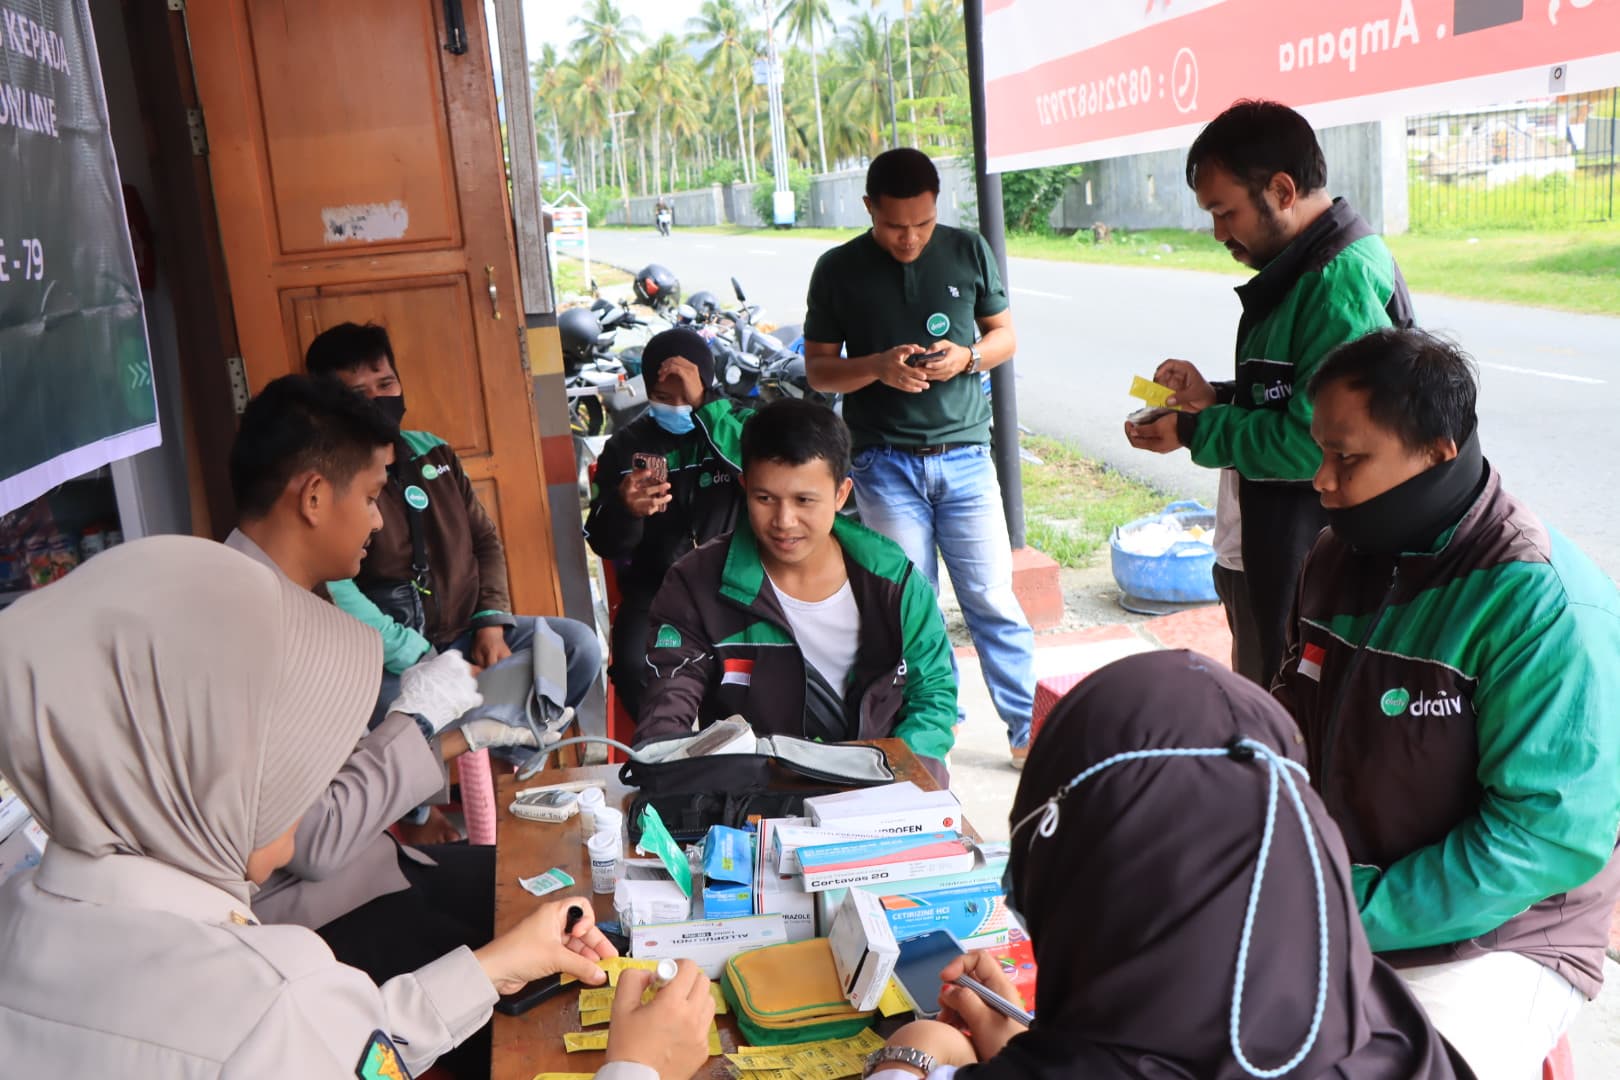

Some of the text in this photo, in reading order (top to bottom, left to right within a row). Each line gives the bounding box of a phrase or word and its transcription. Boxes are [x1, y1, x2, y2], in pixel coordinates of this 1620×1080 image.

[3, 8, 71, 76] KEPADA
[1409, 689, 1461, 716] draiv
[811, 875, 868, 887] Cortavas
[871, 872, 889, 880] 20
